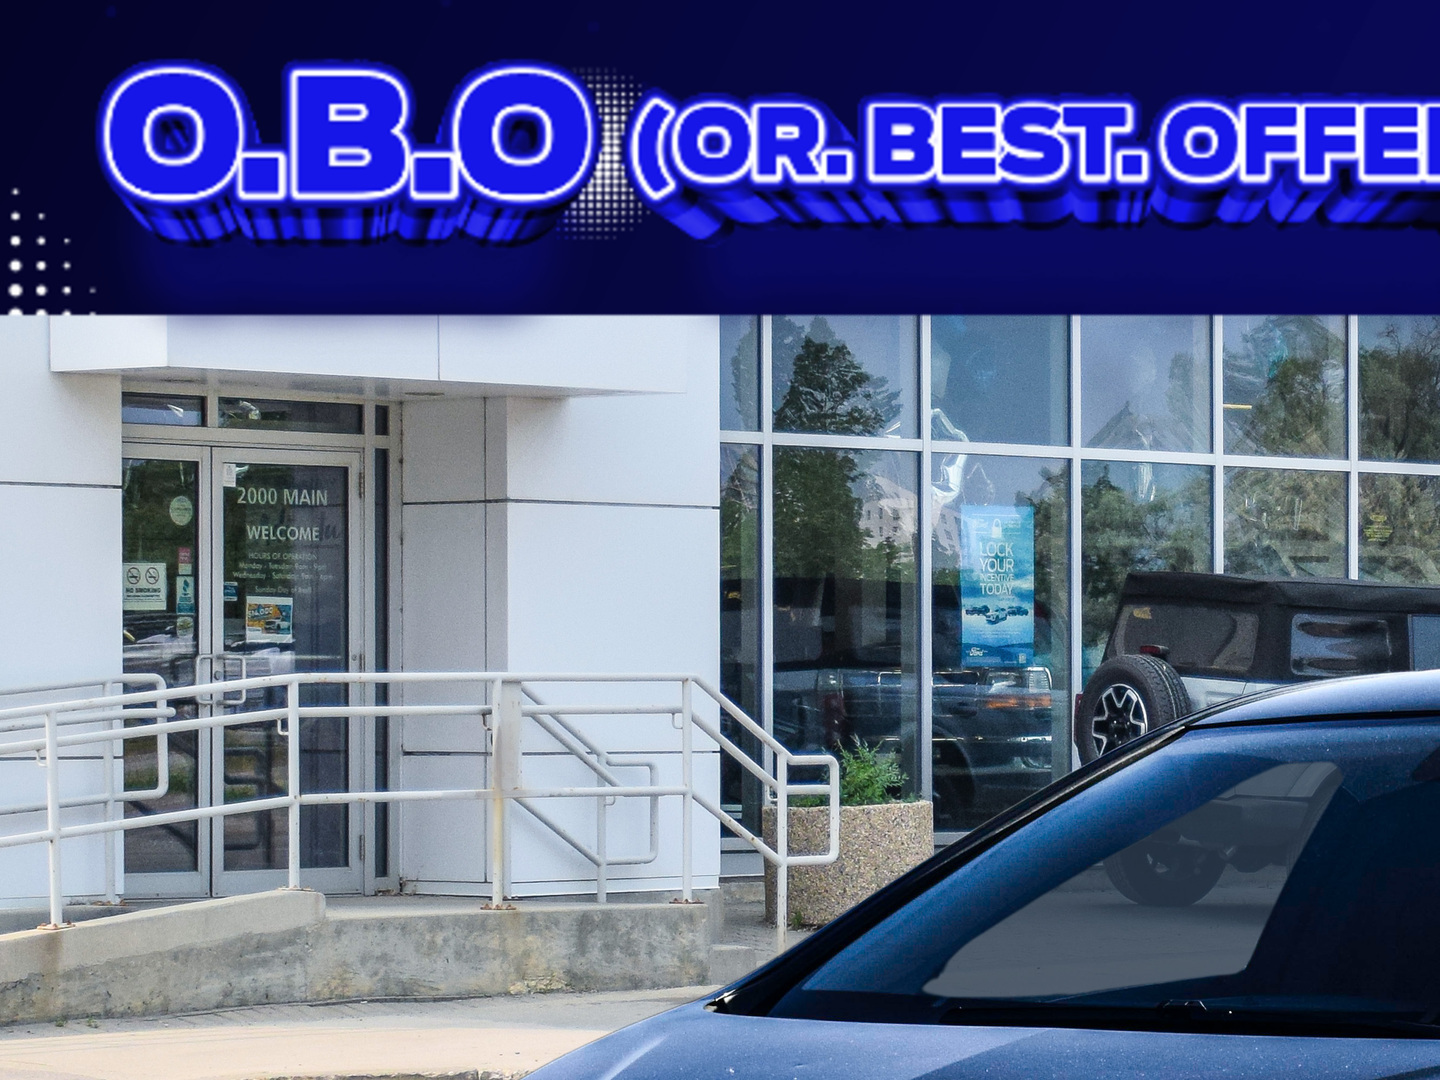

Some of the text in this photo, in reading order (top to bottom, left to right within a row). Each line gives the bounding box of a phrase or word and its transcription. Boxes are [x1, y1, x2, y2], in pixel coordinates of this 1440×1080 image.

[236, 487, 328, 506] 2000 MAIN
[245, 524, 320, 541] WELCOME
[249, 552, 271, 560] HOURS
[979, 541, 1014, 557] LOCK
[979, 558, 1015, 572] YOUR
[980, 573, 1015, 582] INCENTIVE
[980, 583, 1014, 596] TODAY
